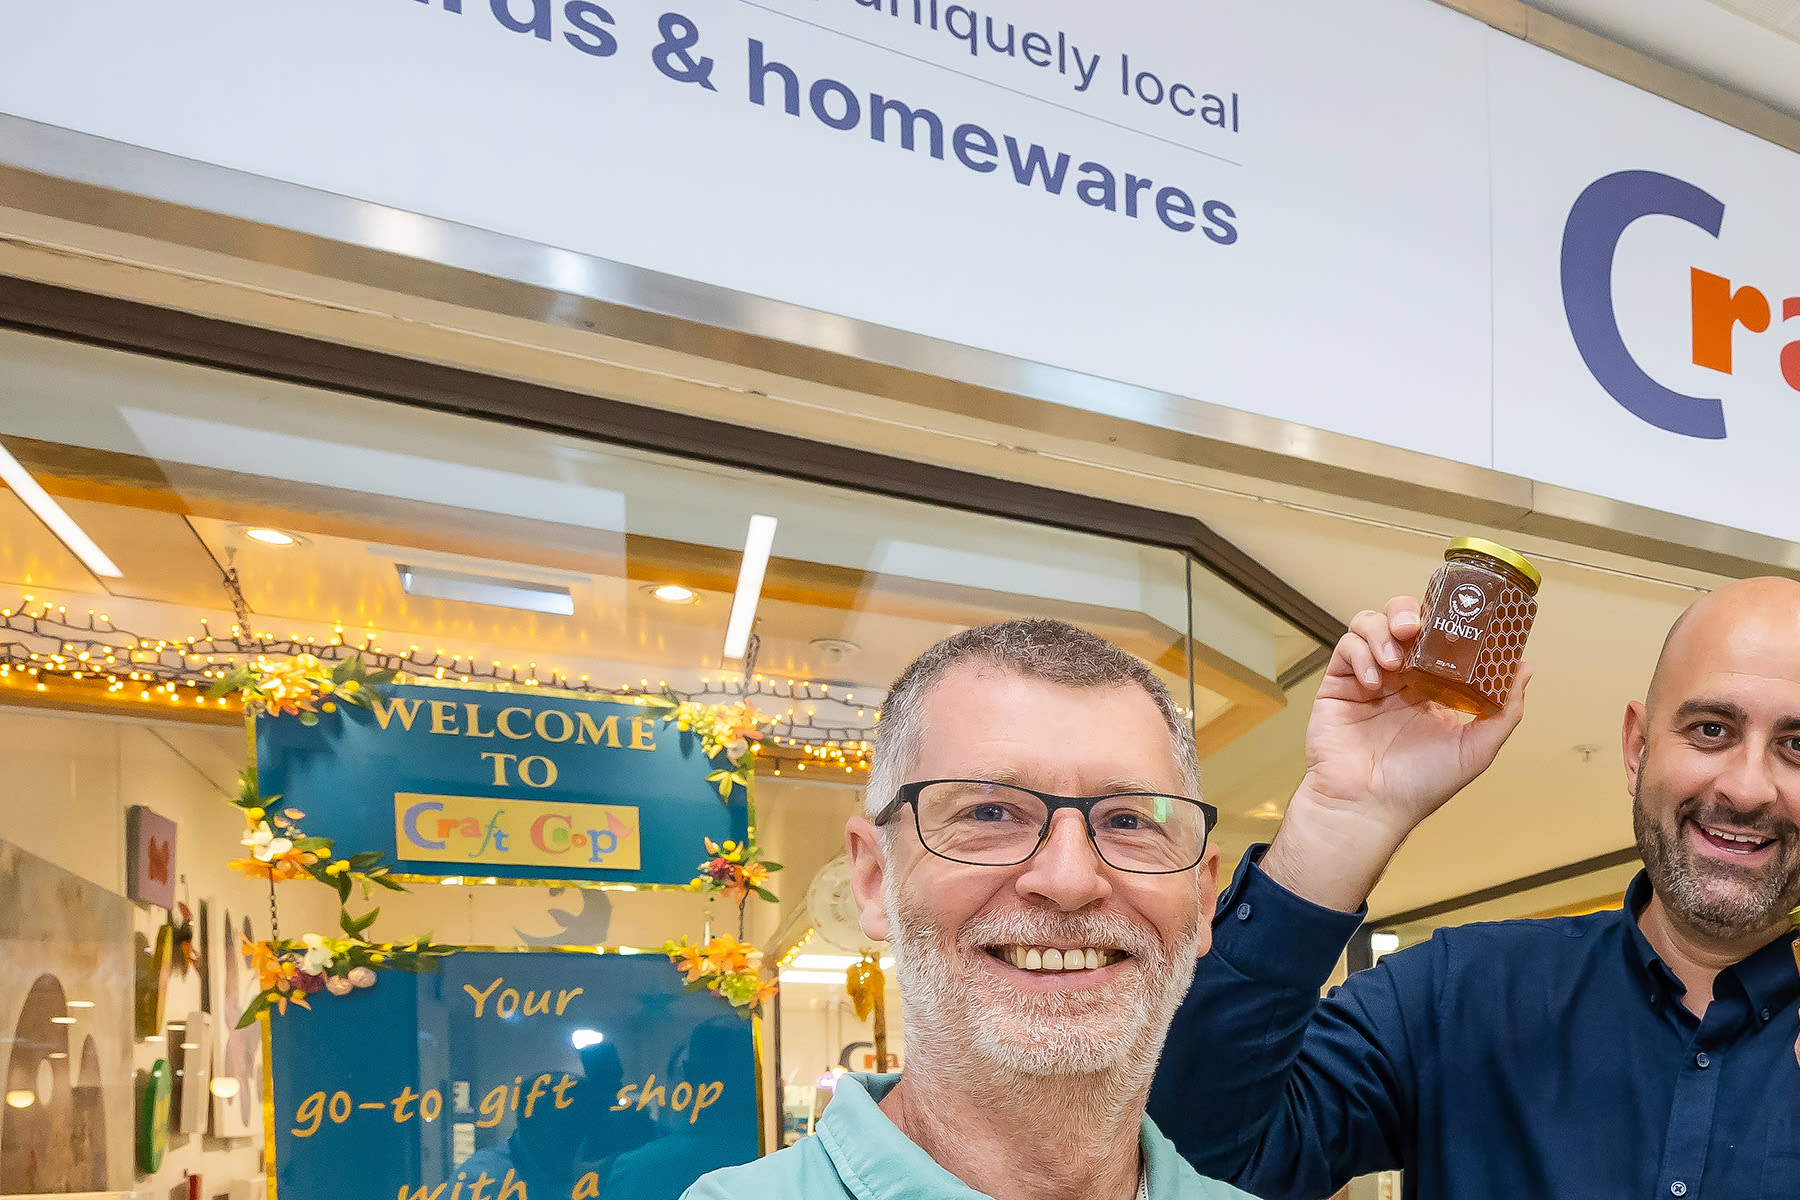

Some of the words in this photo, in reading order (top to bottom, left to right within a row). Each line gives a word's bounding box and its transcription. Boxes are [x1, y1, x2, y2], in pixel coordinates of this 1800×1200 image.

[855, 0, 1100, 92] iquely
[1121, 53, 1240, 133] local
[651, 12, 718, 92] &
[748, 37, 1239, 246] homewares
[1432, 616, 1484, 642] HONEY
[371, 697, 657, 751] WELCOME
[481, 751, 559, 789] TO
[402, 801, 509, 859] Craft
[530, 813, 618, 863] Coop
[463, 977, 584, 1020] Your
[291, 1085, 443, 1138] go-to
[476, 1073, 581, 1128] gift
[610, 1073, 725, 1124] shop
